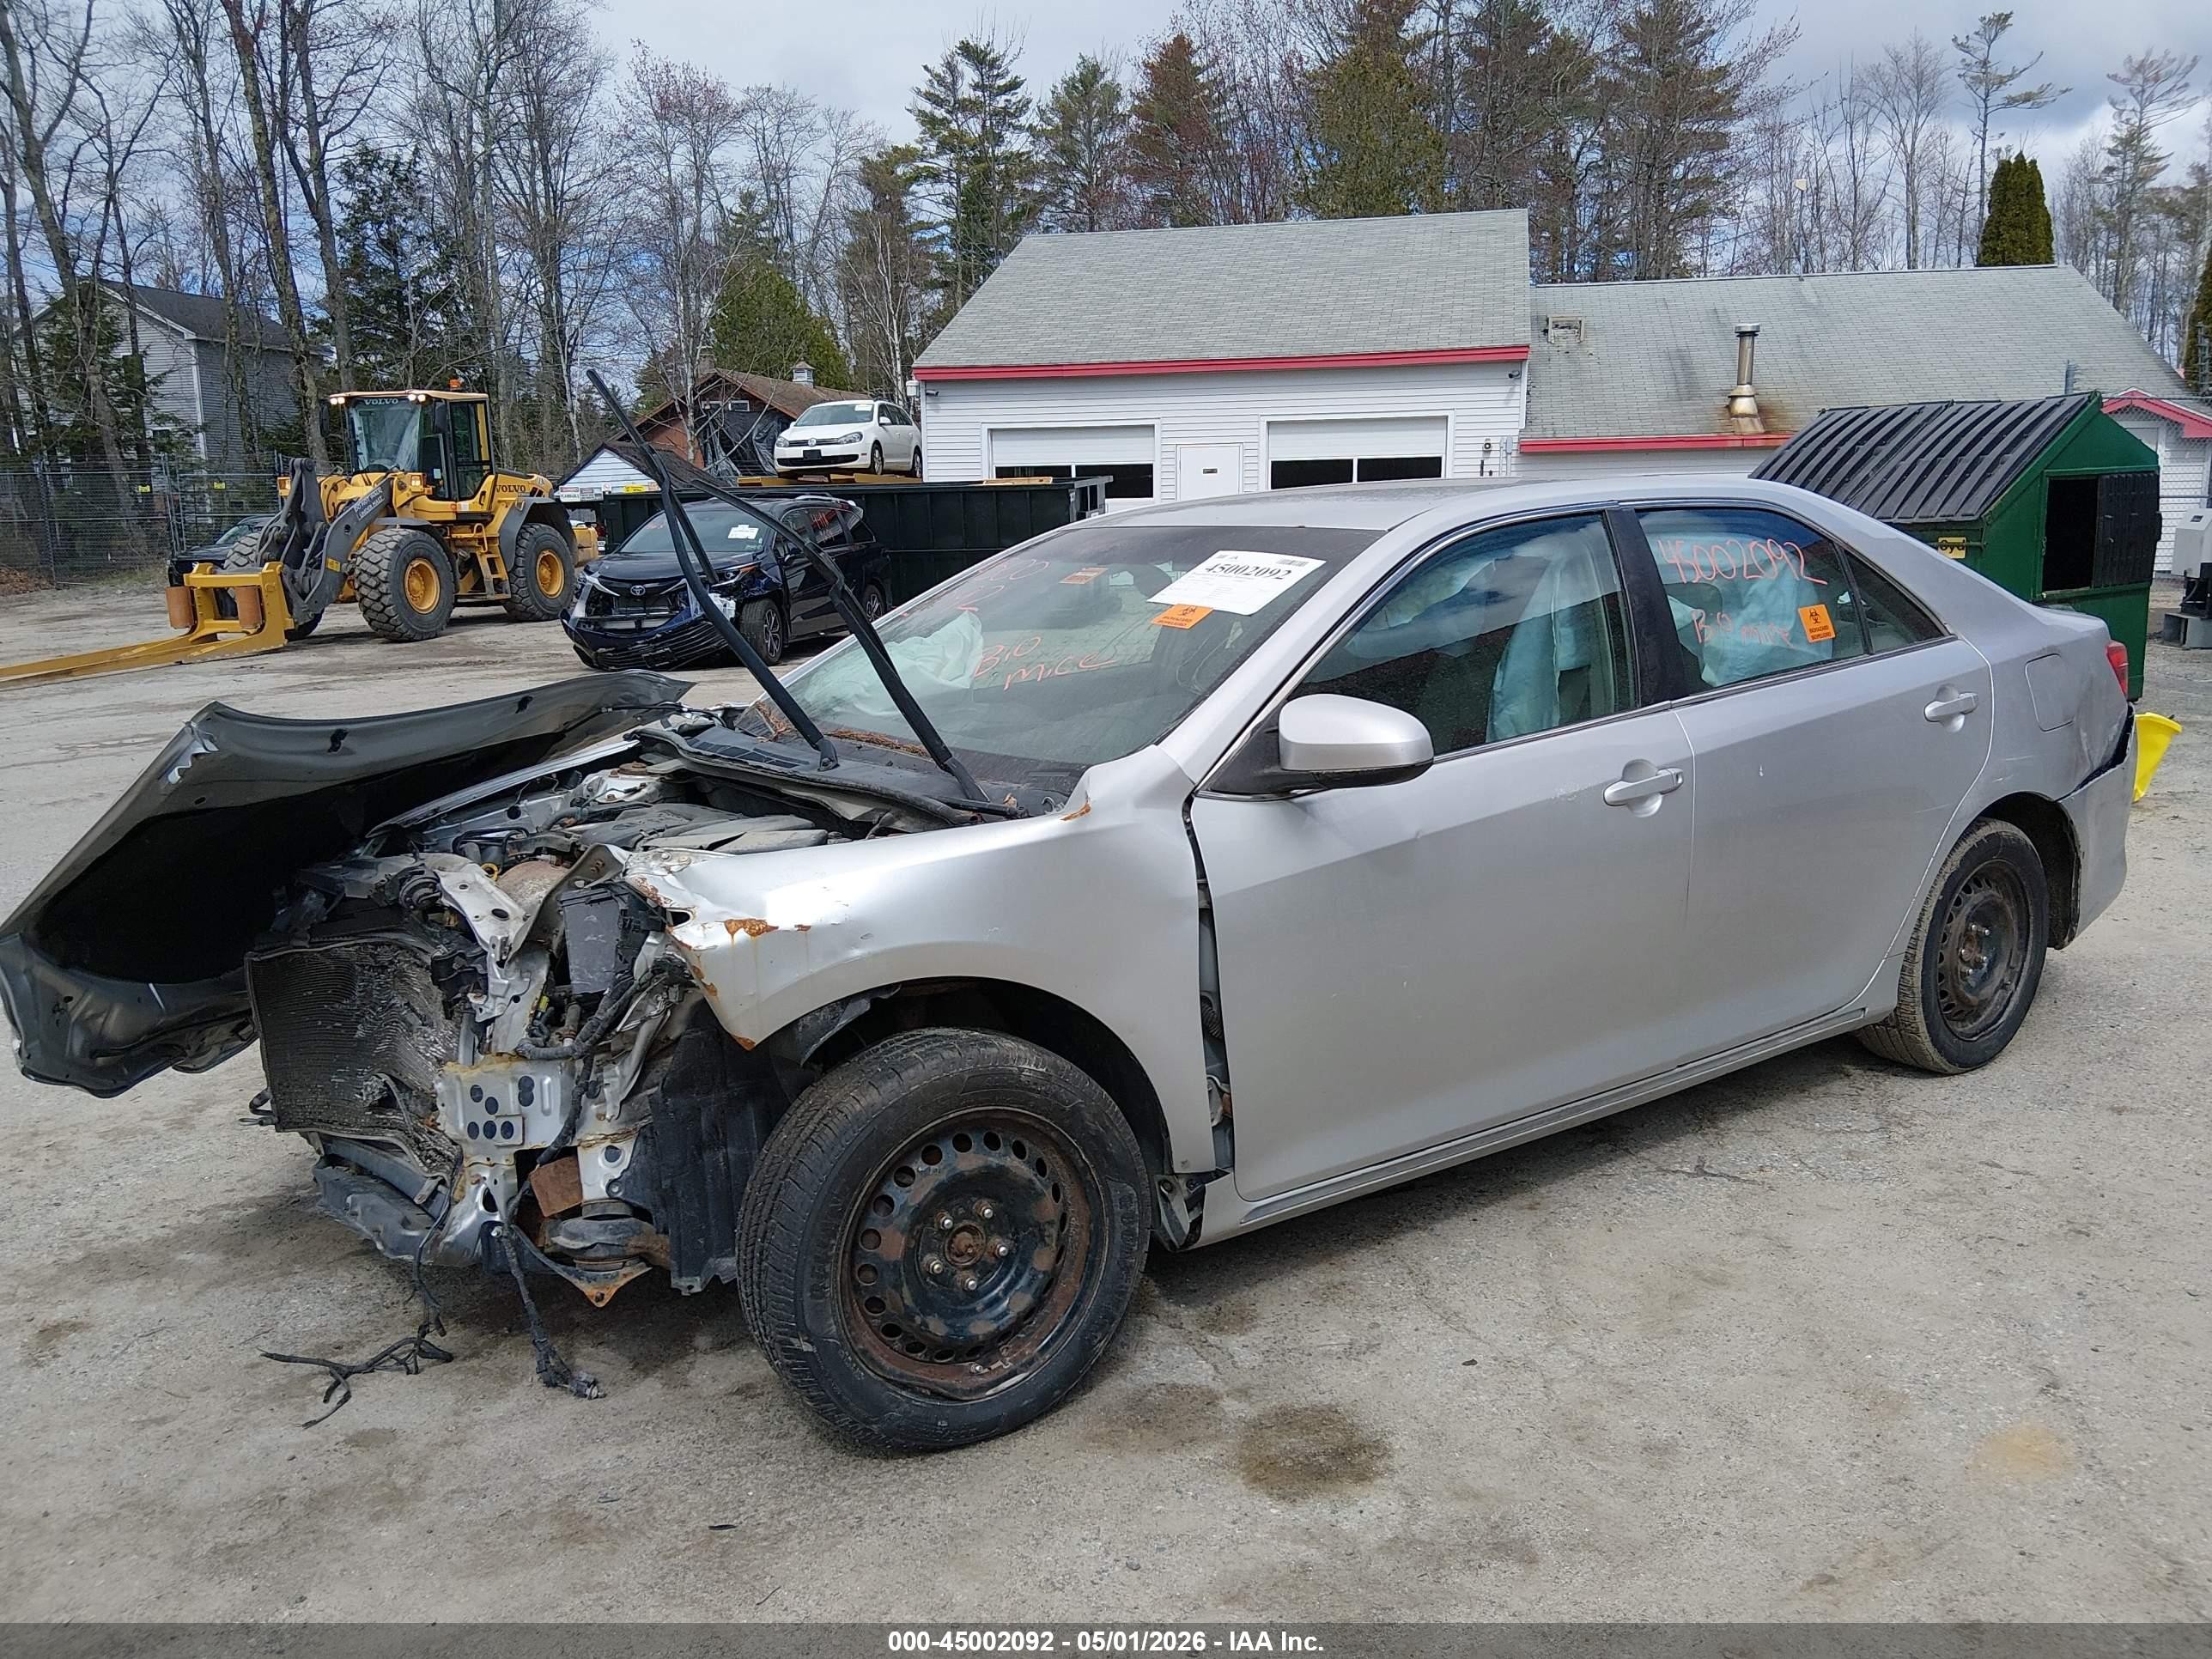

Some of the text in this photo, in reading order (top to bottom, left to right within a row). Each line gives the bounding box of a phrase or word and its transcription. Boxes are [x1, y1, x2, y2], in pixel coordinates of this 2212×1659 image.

[495, 484, 526, 493] VOLVO
[1657, 538, 1828, 585] 45002092
[1205, 562, 1292, 580] 45002092
